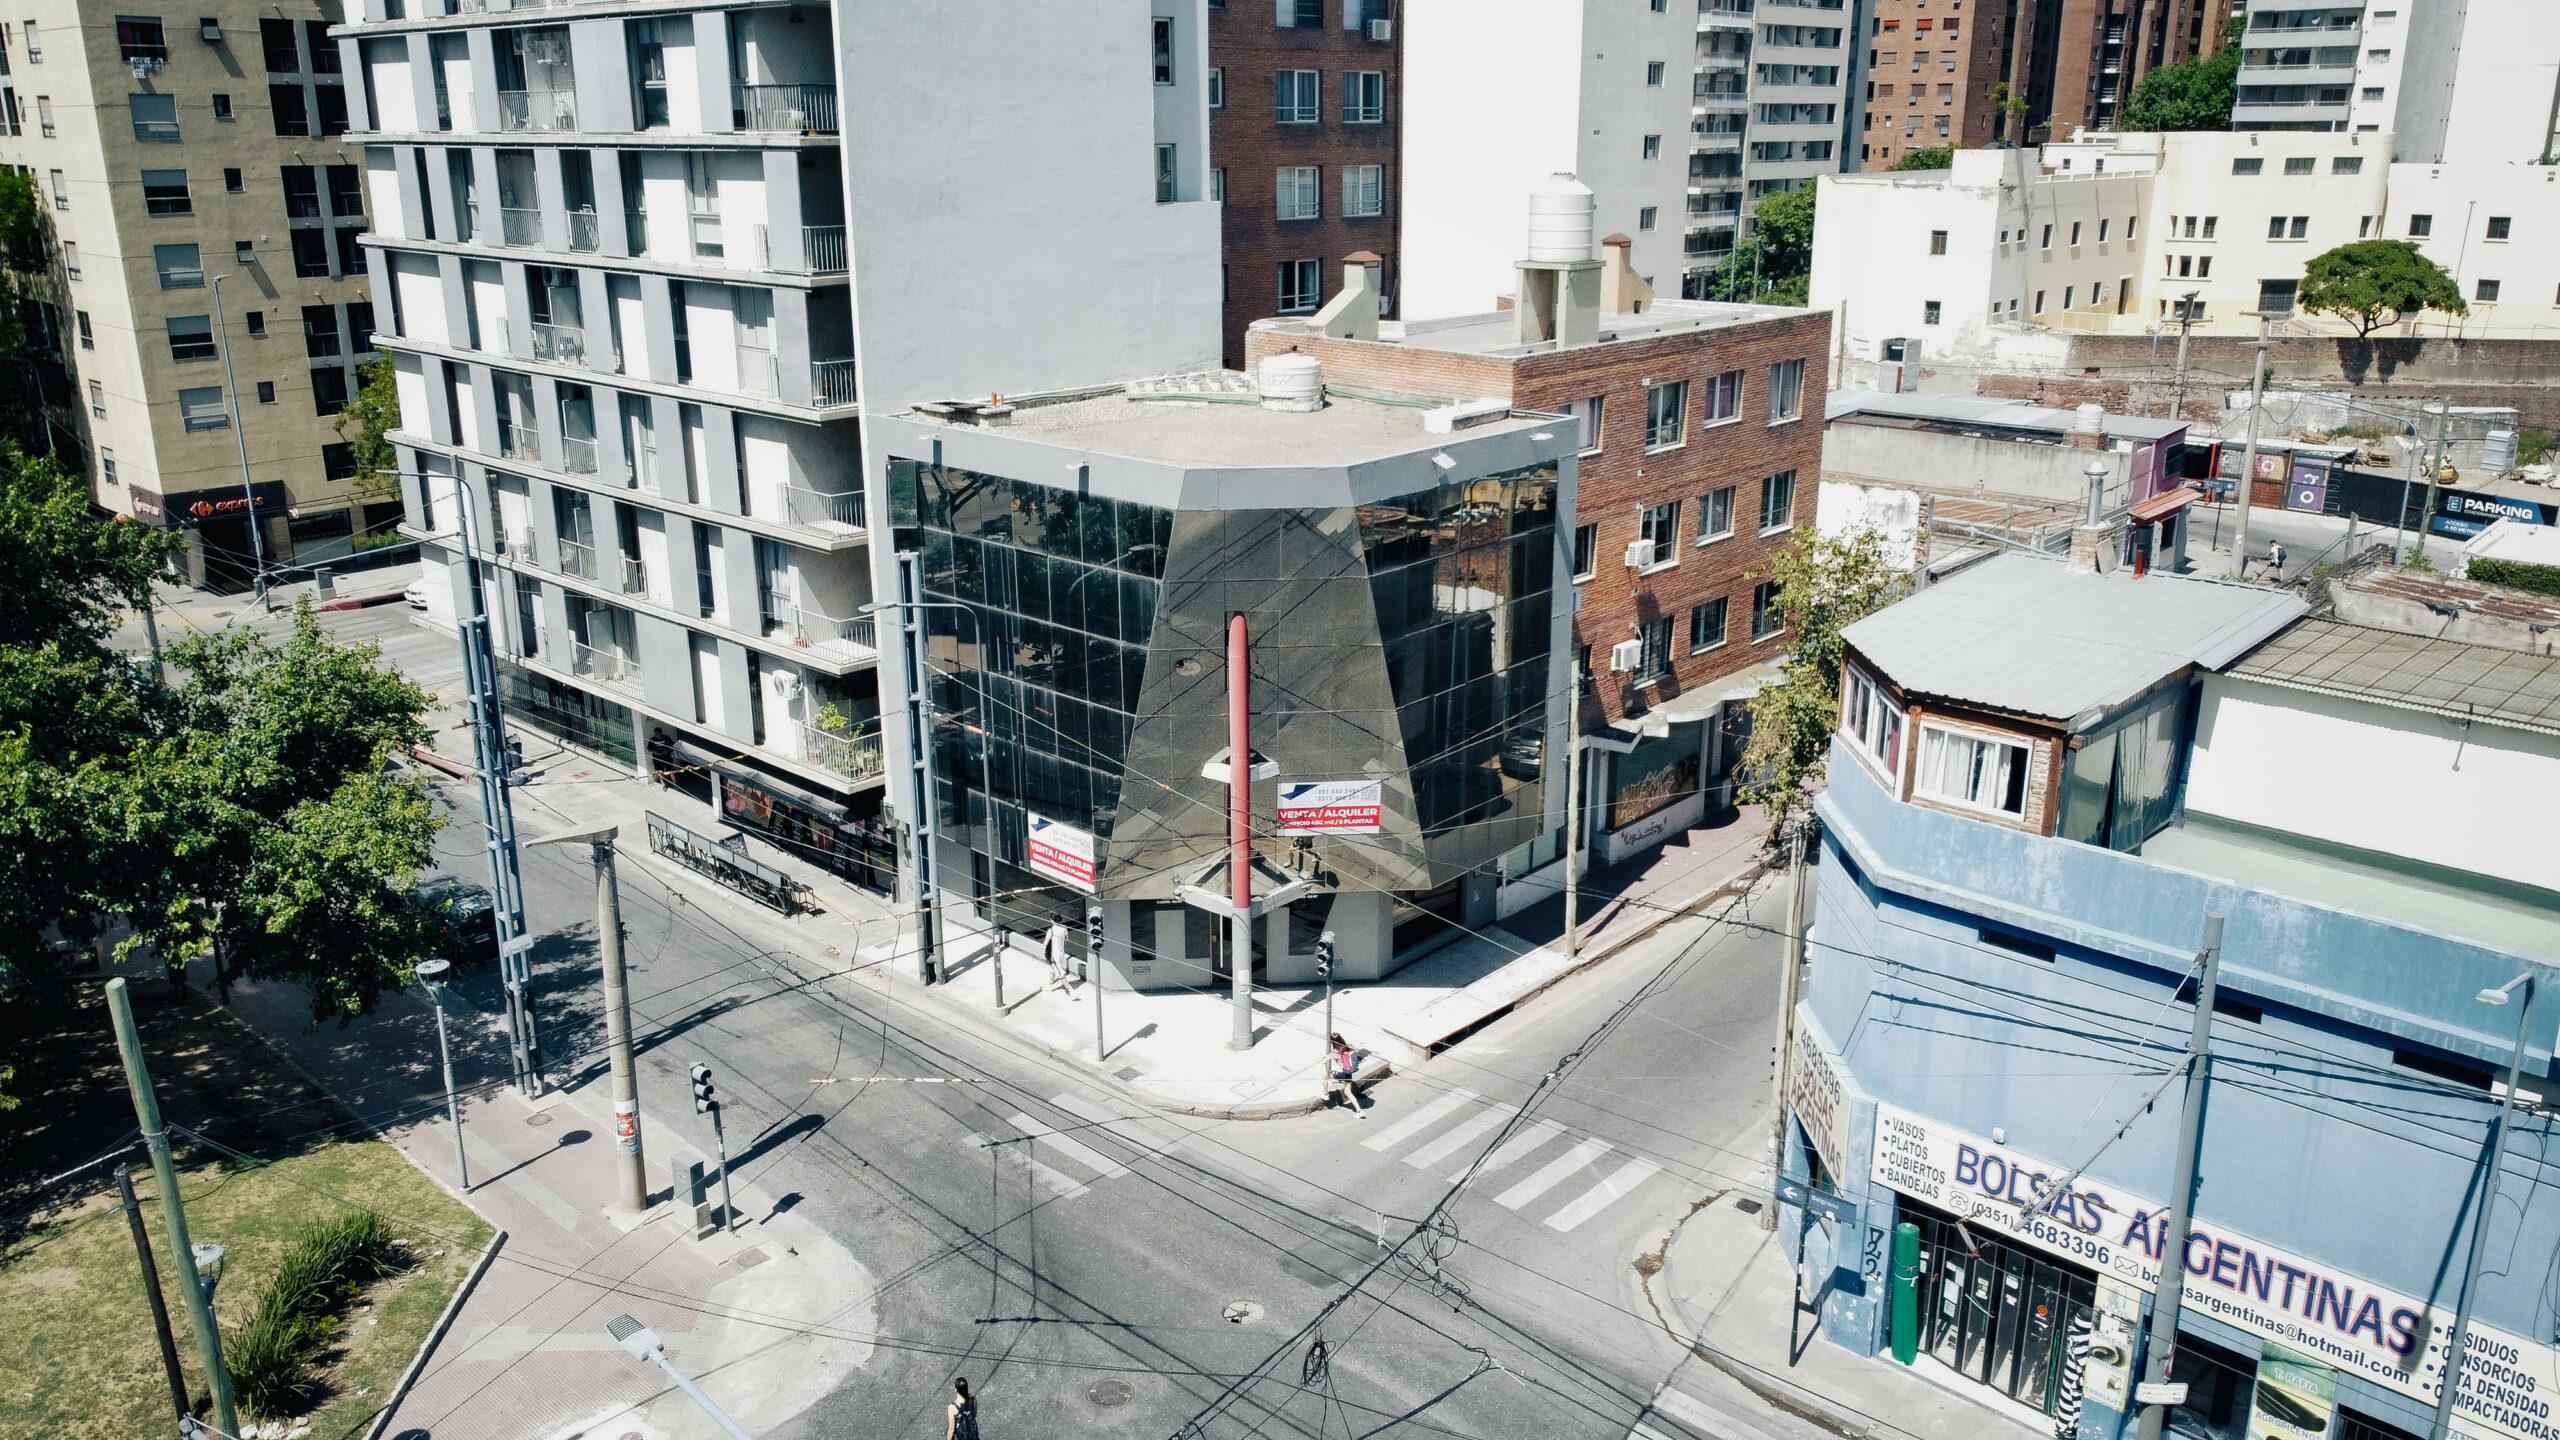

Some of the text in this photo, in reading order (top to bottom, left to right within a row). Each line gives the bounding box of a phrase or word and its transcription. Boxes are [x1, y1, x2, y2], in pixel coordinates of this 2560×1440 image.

[2465, 499, 2533, 520] PARKING
[1280, 810, 1317, 819] VENTA
[1324, 808, 1378, 818] ALQUILER
[1029, 841, 1054, 858] VENTA
[1058, 852, 1094, 873] ALQUILER
[1801, 1028, 1841, 1106] 4683396
[1803, 1061, 1834, 1132] BOLSAS
[1791, 1076, 1842, 1181] ARGENTINAS
[1893, 1117, 1926, 1142] VASOS
[1891, 1134, 1928, 1160] PLATOS
[1887, 1168, 1940, 1199] BANDEJAS
[1889, 1151, 1946, 1184] CUBIERTOS
[1811, 1194, 1839, 1210] Belgrano
[1971, 1202, 2014, 1231] (0351)
[2445, 1325, 2519, 1365] RSIDUOS
[2285, 1372, 2319, 1395] RAFIA
[2441, 1345, 2536, 1393] CNSORCIOS
[2437, 1364, 2550, 1419] ATA DENSIDAD
[2434, 1383, 2560, 1440] CMPACTADORAS
